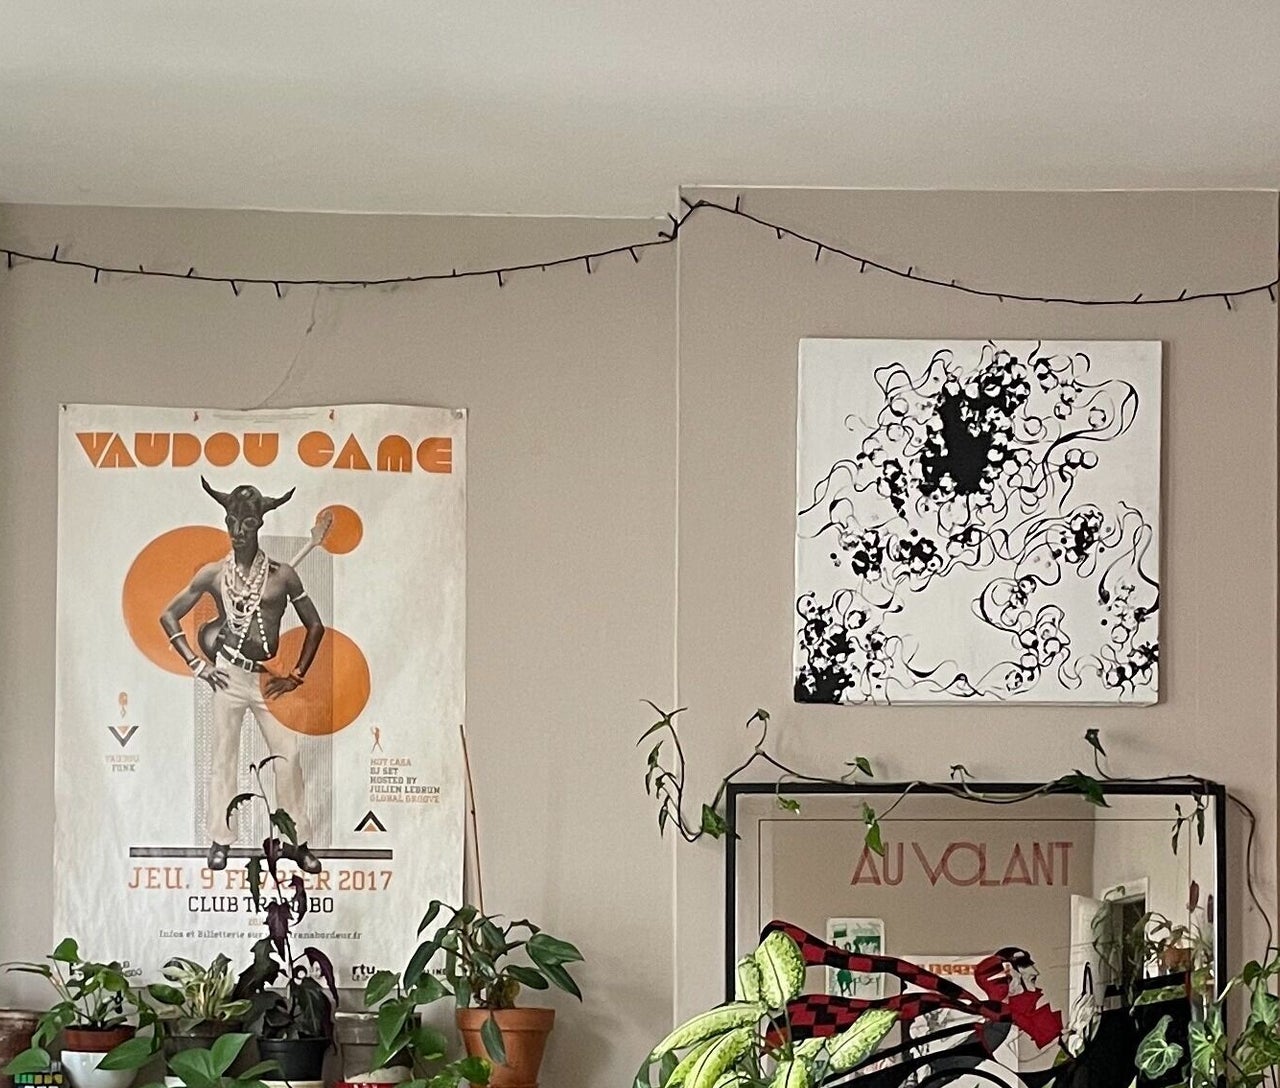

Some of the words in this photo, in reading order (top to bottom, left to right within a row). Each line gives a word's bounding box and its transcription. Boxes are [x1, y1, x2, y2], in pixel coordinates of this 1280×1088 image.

[75, 431, 280, 468] VAUDOU
[382, 767, 399, 775] SET
[370, 776, 404, 784] HOSTED
[406, 777, 417, 785] BY
[370, 785, 402, 793] JULIEN
[370, 794, 404, 802] GLOBAL
[405, 795, 441, 803] GROOVE
[850, 841, 904, 886] AU
[911, 841, 1074, 887] VOLANT
[127, 867, 190, 890] JEU.
[200, 868, 215, 890] 9
[339, 870, 393, 891] 2017
[188, 896, 239, 913] CLUB
[197, 929, 245, 938] Billetterie
[247, 931, 263, 939] sur
